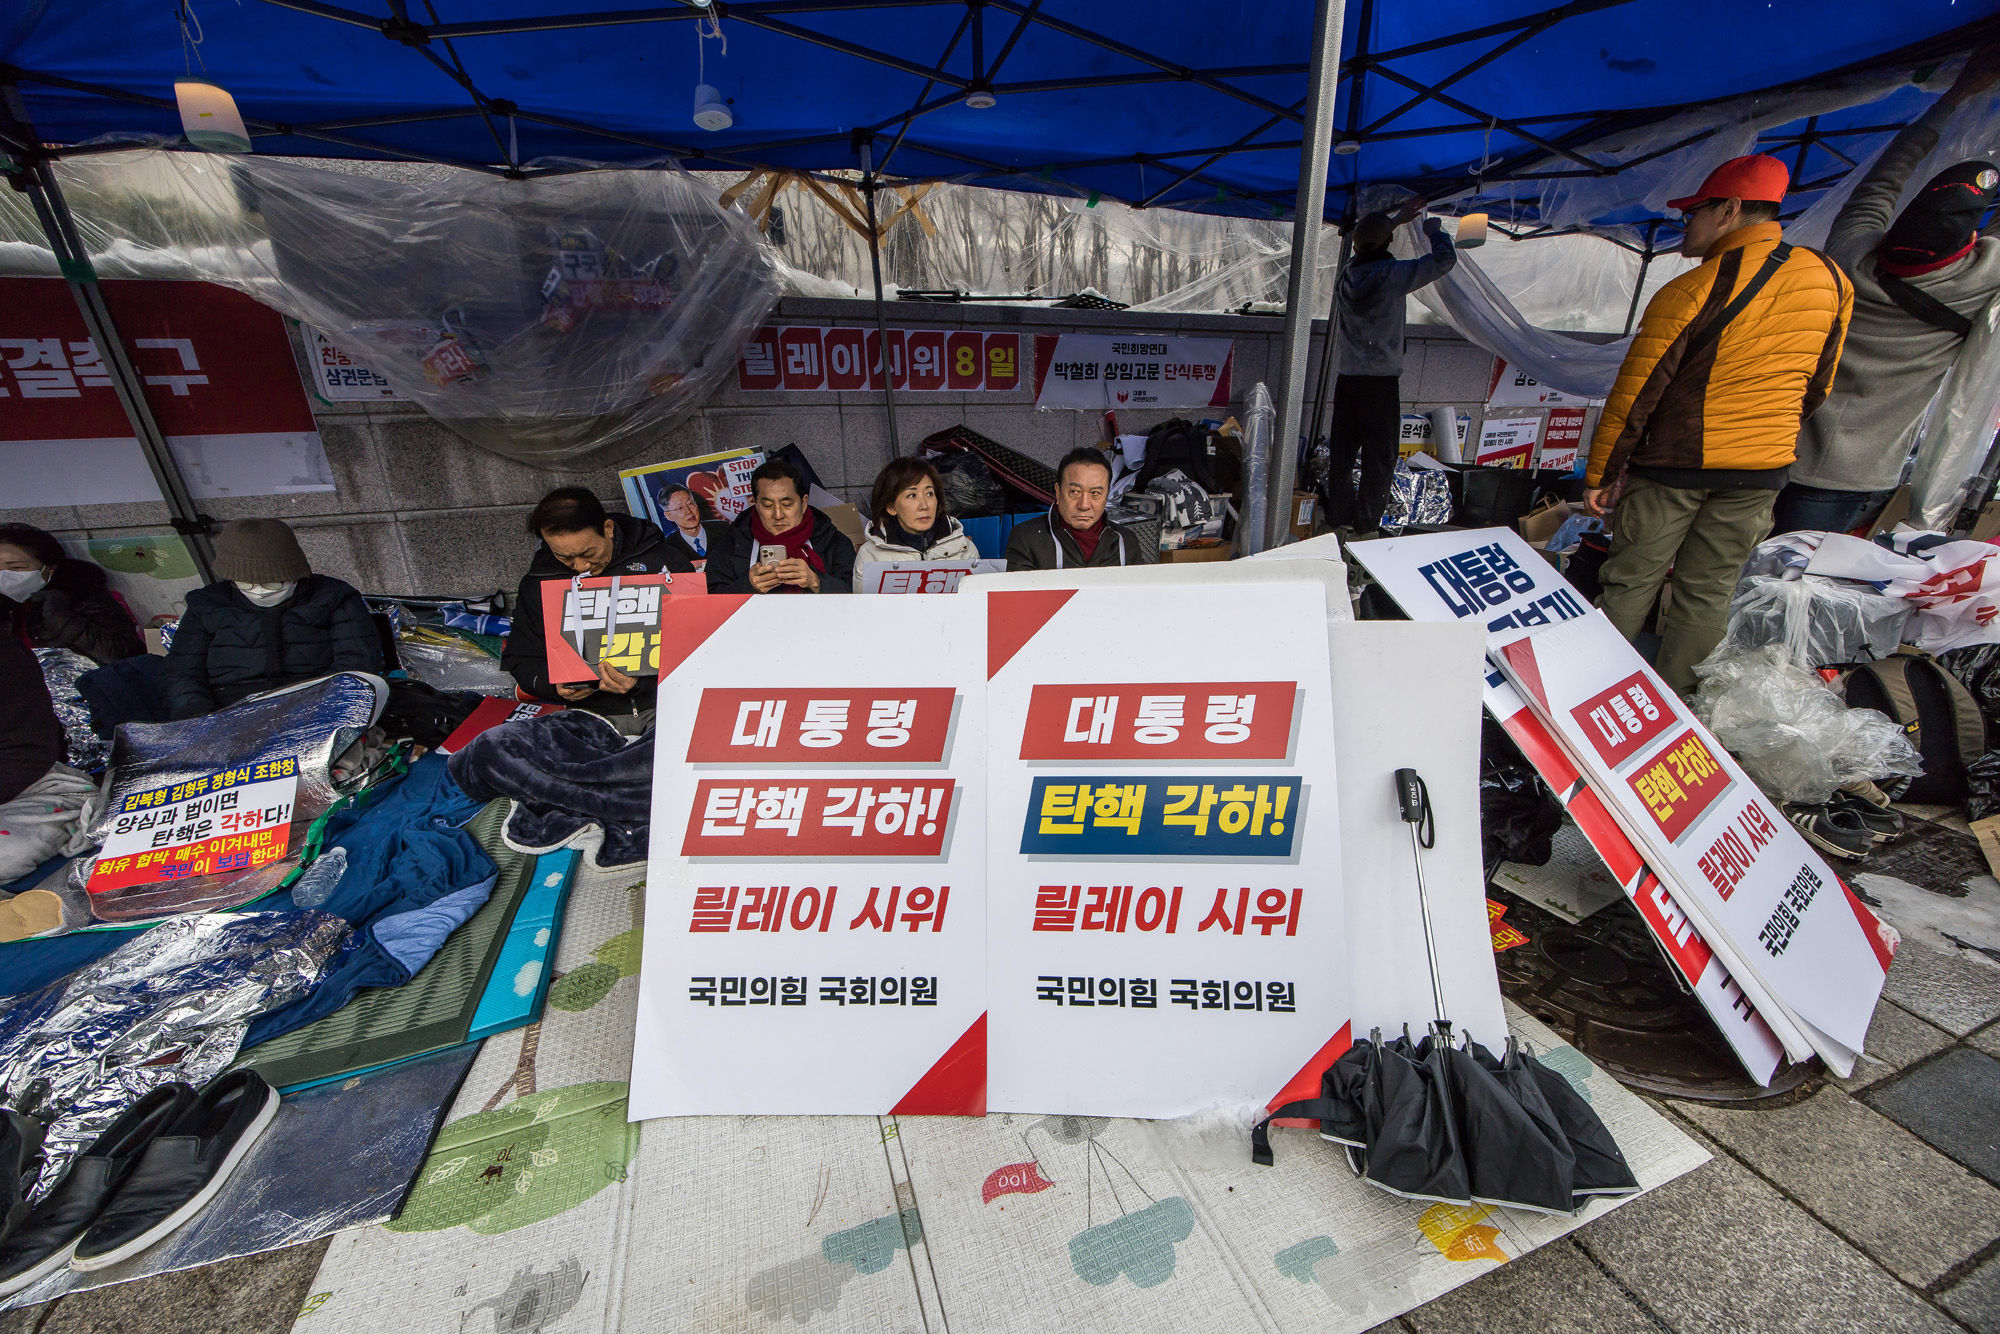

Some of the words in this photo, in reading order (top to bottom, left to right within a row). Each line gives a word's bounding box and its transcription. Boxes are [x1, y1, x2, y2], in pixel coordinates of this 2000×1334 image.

[1054, 362, 1099, 381] 박철희
[1104, 362, 1160, 381] 상임고문
[1164, 363, 1217, 382] 단식투쟁
[1112, 342, 1168, 356] 국민희망연대
[728, 458, 758, 472] STOP
[720, 496, 745, 515] 헌법
[1417, 541, 1536, 619] 대통령
[563, 586, 661, 632] 탄핵
[124, 789, 168, 812] 김복형
[171, 778, 208, 803] 김형두
[211, 766, 250, 790] 정형식
[253, 758, 296, 780] 조한창
[1634, 761, 1688, 823] 탄핵
[1666, 735, 1719, 787] 각하!
[114, 806, 178, 835] 양심과
[185, 790, 239, 823] 법이면
[150, 819, 213, 849] 탄핵은
[219, 803, 291, 833] 각하다!
[700, 786, 809, 836] 탄핵
[821, 786, 945, 836] 각하!
[1038, 784, 1148, 836] 탄핵
[1163, 784, 1292, 836] 각하!
[96, 857, 131, 876] 회유
[135, 850, 170, 869] 협박
[174, 843, 206, 862] 매수
[209, 830, 273, 854] 이겨내면
[158, 857, 211, 879] 국민이
[215, 843, 286, 870] 보답한다!
[1697, 825, 1756, 903] 릴레이
[1736, 798, 1778, 853] 시위
[689, 886, 838, 933] 릴레이
[849, 886, 950, 933] 시위
[1032, 885, 1184, 934] 릴레이
[1197, 887, 1304, 937] 시위
[1758, 900, 1801, 958] 국민의힘
[1783, 863, 1823, 914] 국회의원
[688, 976, 808, 1007] 국민의힘
[819, 976, 938, 1007] 국회의원
[1036, 976, 1158, 1009] 국민의힘
[1169, 979, 1297, 1013] 국회의원
